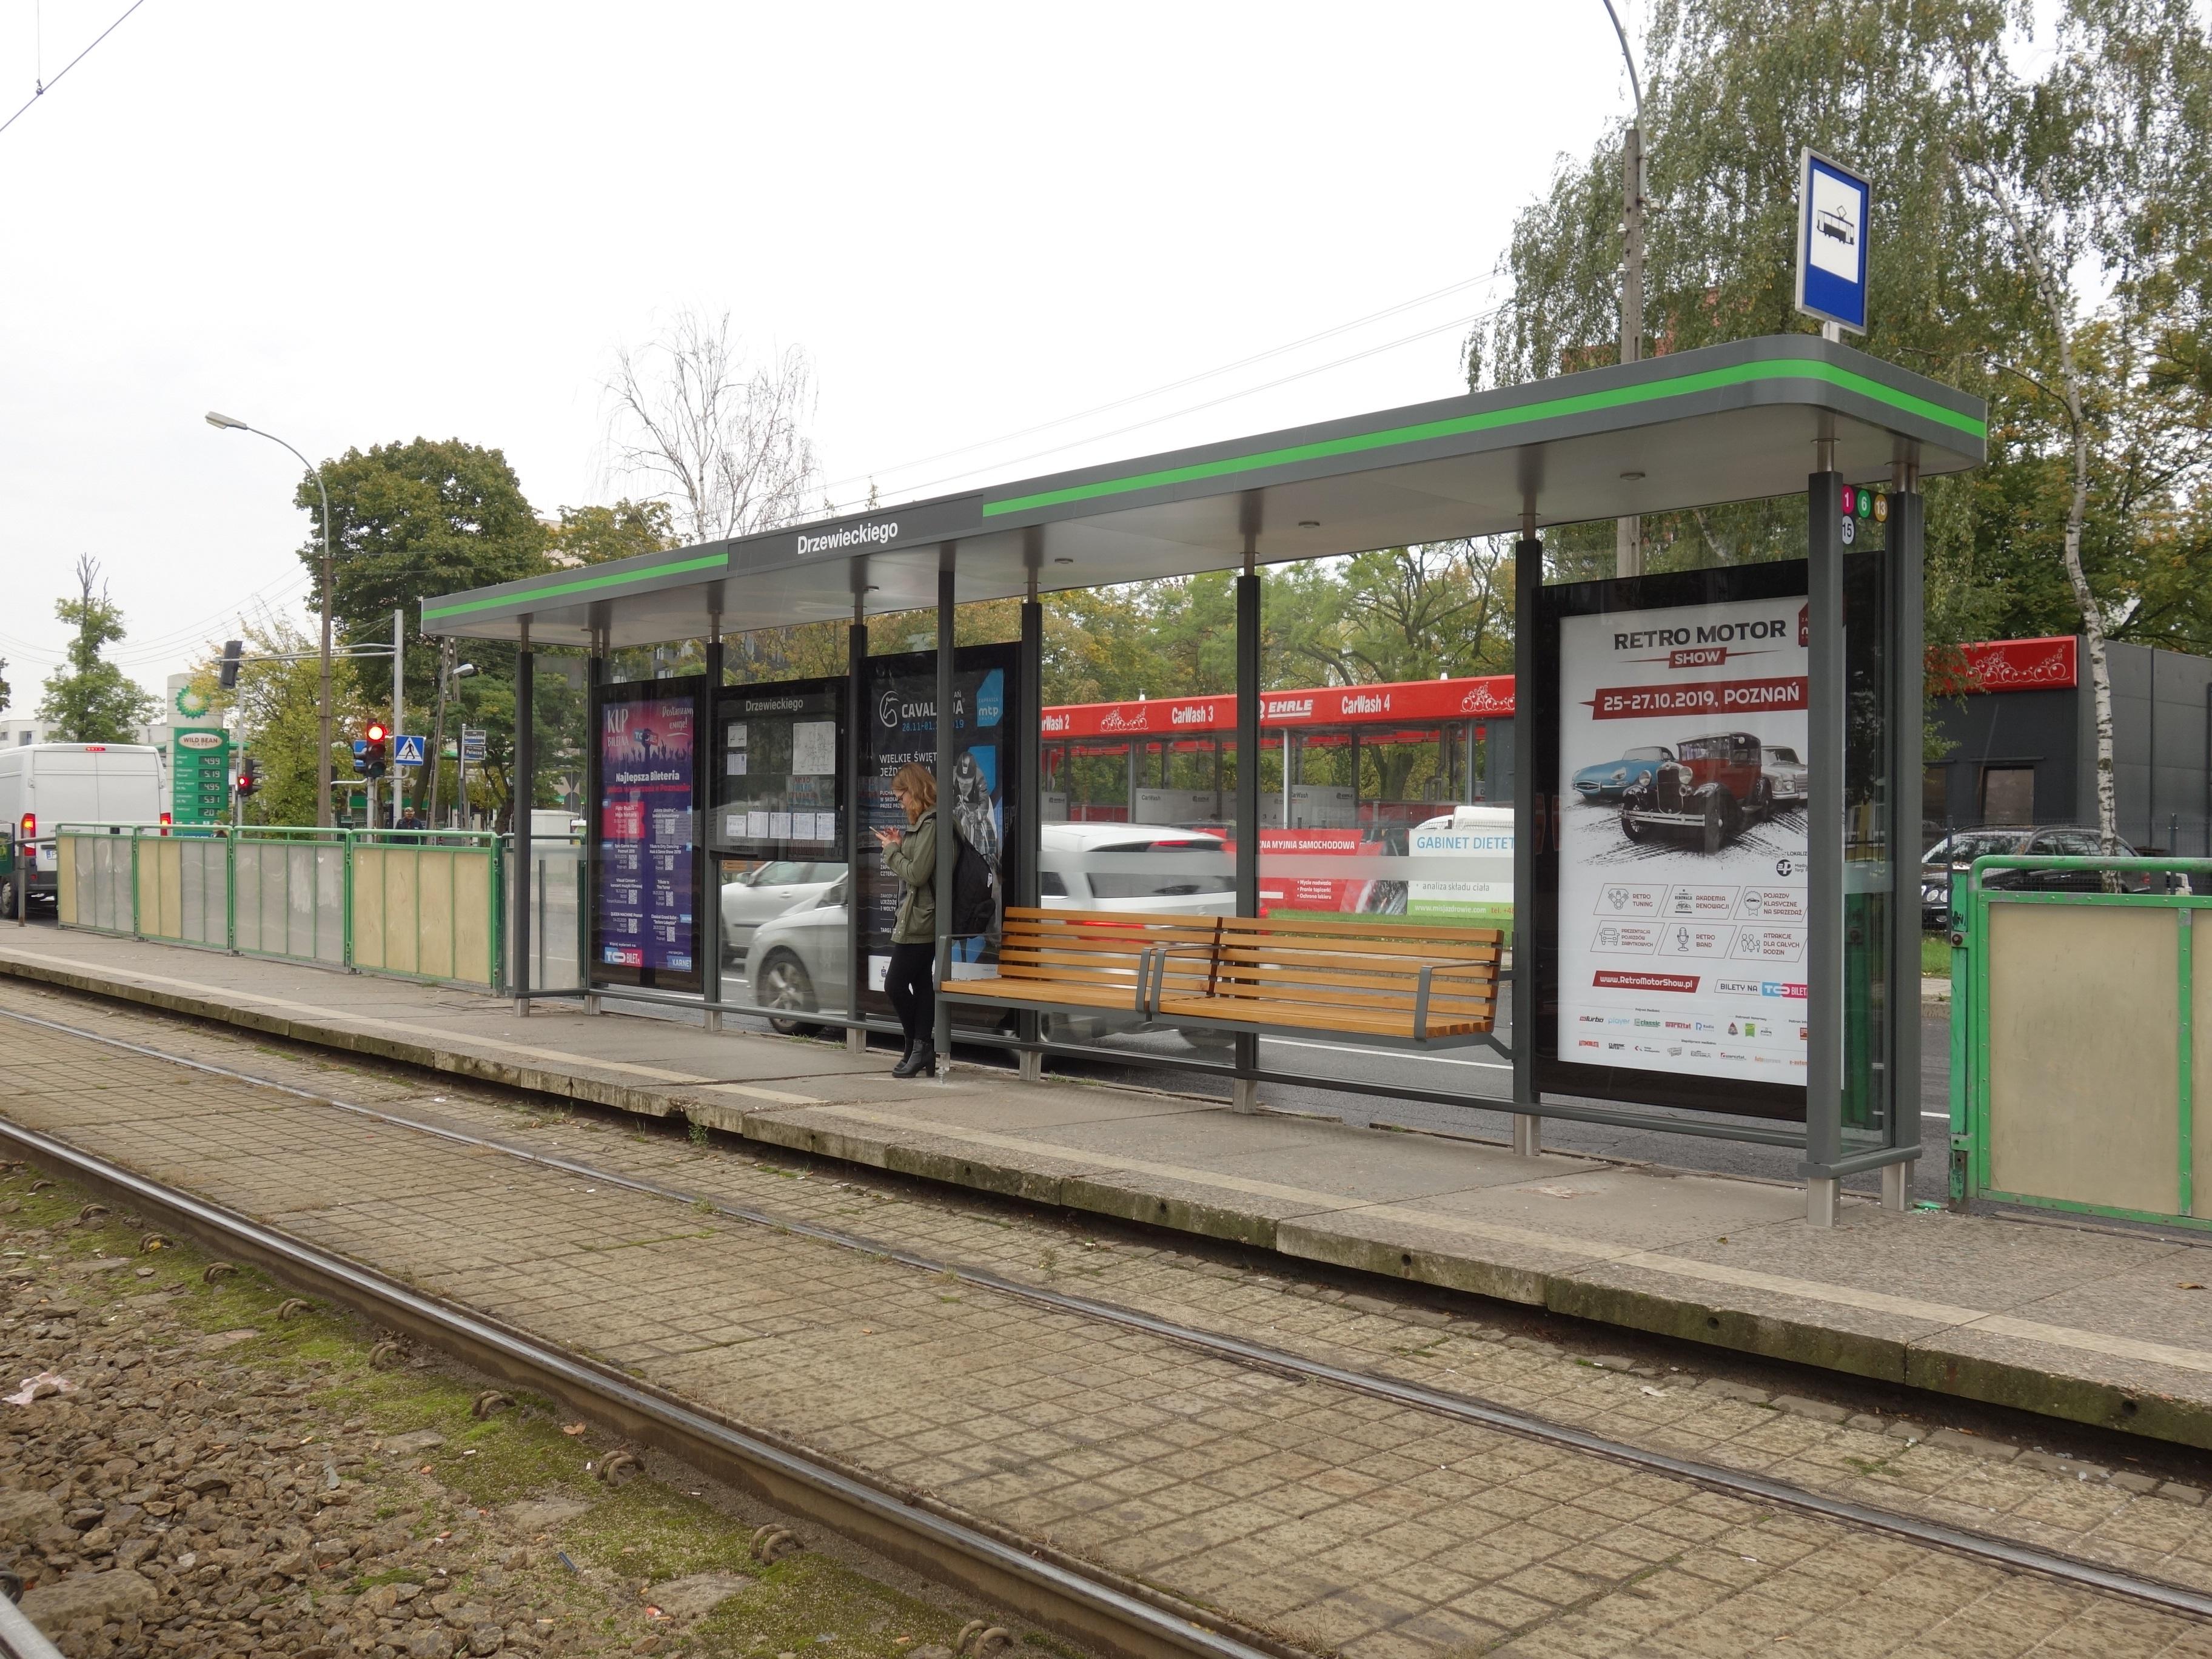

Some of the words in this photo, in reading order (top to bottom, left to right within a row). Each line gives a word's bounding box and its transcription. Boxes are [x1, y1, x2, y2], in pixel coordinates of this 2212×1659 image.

[1845, 492, 1849, 507] 1
[1862, 497, 1867, 511] 6
[1876, 501, 1886, 515] 13
[1842, 523, 1852, 537] 15
[797, 522, 898, 554] Drzewieckiego
[1614, 628, 1691, 650] RETRO
[1697, 620, 1786, 643] MOTOR
[1675, 650, 1720, 665] SHOW
[1604, 690, 1718, 711] 25-27.10.2019,
[1724, 682, 1799, 705] POZNAŃ
[746, 699, 803, 711] Drzewieckiego
[1269, 699, 1313, 713] EHRLE
[1341, 694, 1381, 714] CarWash
[1384, 694, 1390, 711] 4
[979, 706, 999, 717] mtp
[1171, 705, 1205, 725] CarWash
[1208, 705, 1213, 722] 3
[607, 708, 628, 733] KUP
[1065, 714, 1070, 729] 2
[879, 753, 911, 763] WIELKIE
[914, 751, 937, 763] ŚWIĘT
[615, 772, 649, 784] Najlepsza
[650, 769, 680, 781] Bileteria
[1272, 840, 1297, 850] MYJNIA
[1299, 840, 1355, 850] SAMOCHODOWA
[1416, 836, 1470, 850] GABINET
[1448, 883, 1470, 891] składu
[1472, 883, 1490, 892] ciała
[1415, 904, 1486, 914] www.misjazdrowie.com
[672, 958, 691, 967] KARNET
[1600, 976, 1693, 990] www.RetroMotorShow.pl
